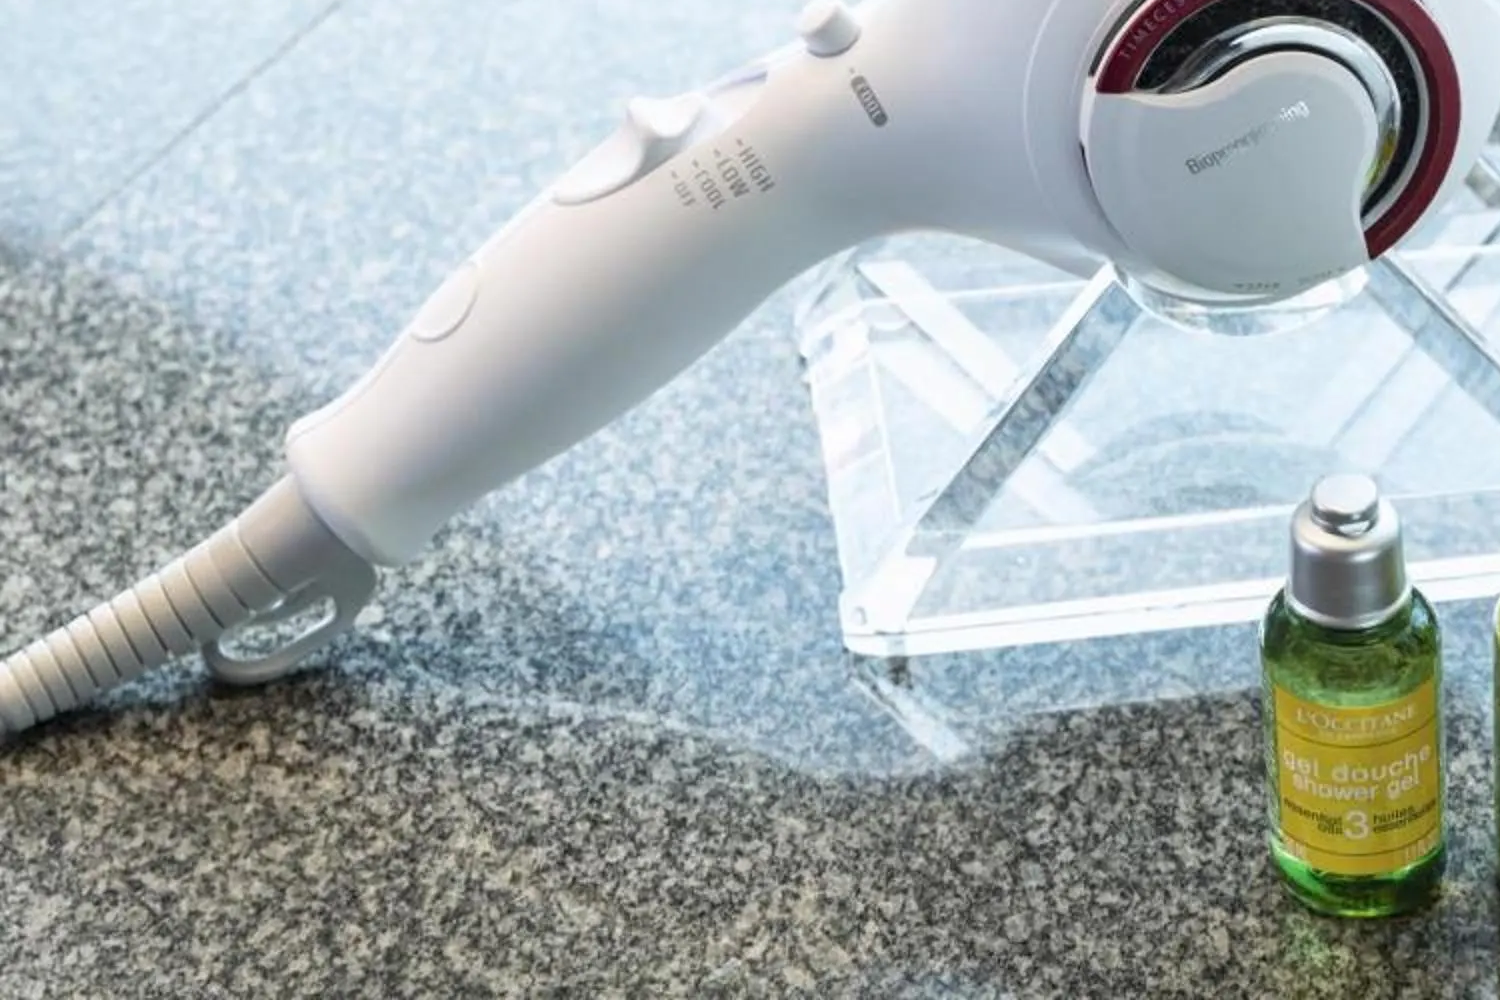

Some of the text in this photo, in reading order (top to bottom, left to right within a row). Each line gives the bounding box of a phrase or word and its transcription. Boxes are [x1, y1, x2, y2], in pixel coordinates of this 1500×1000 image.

[716, 158, 750, 198] LOW
[739, 146, 775, 193] HIGH
[1331, 744, 1432, 783] douche
[1293, 773, 1379, 800] shower
[1343, 809, 1370, 841] 3
